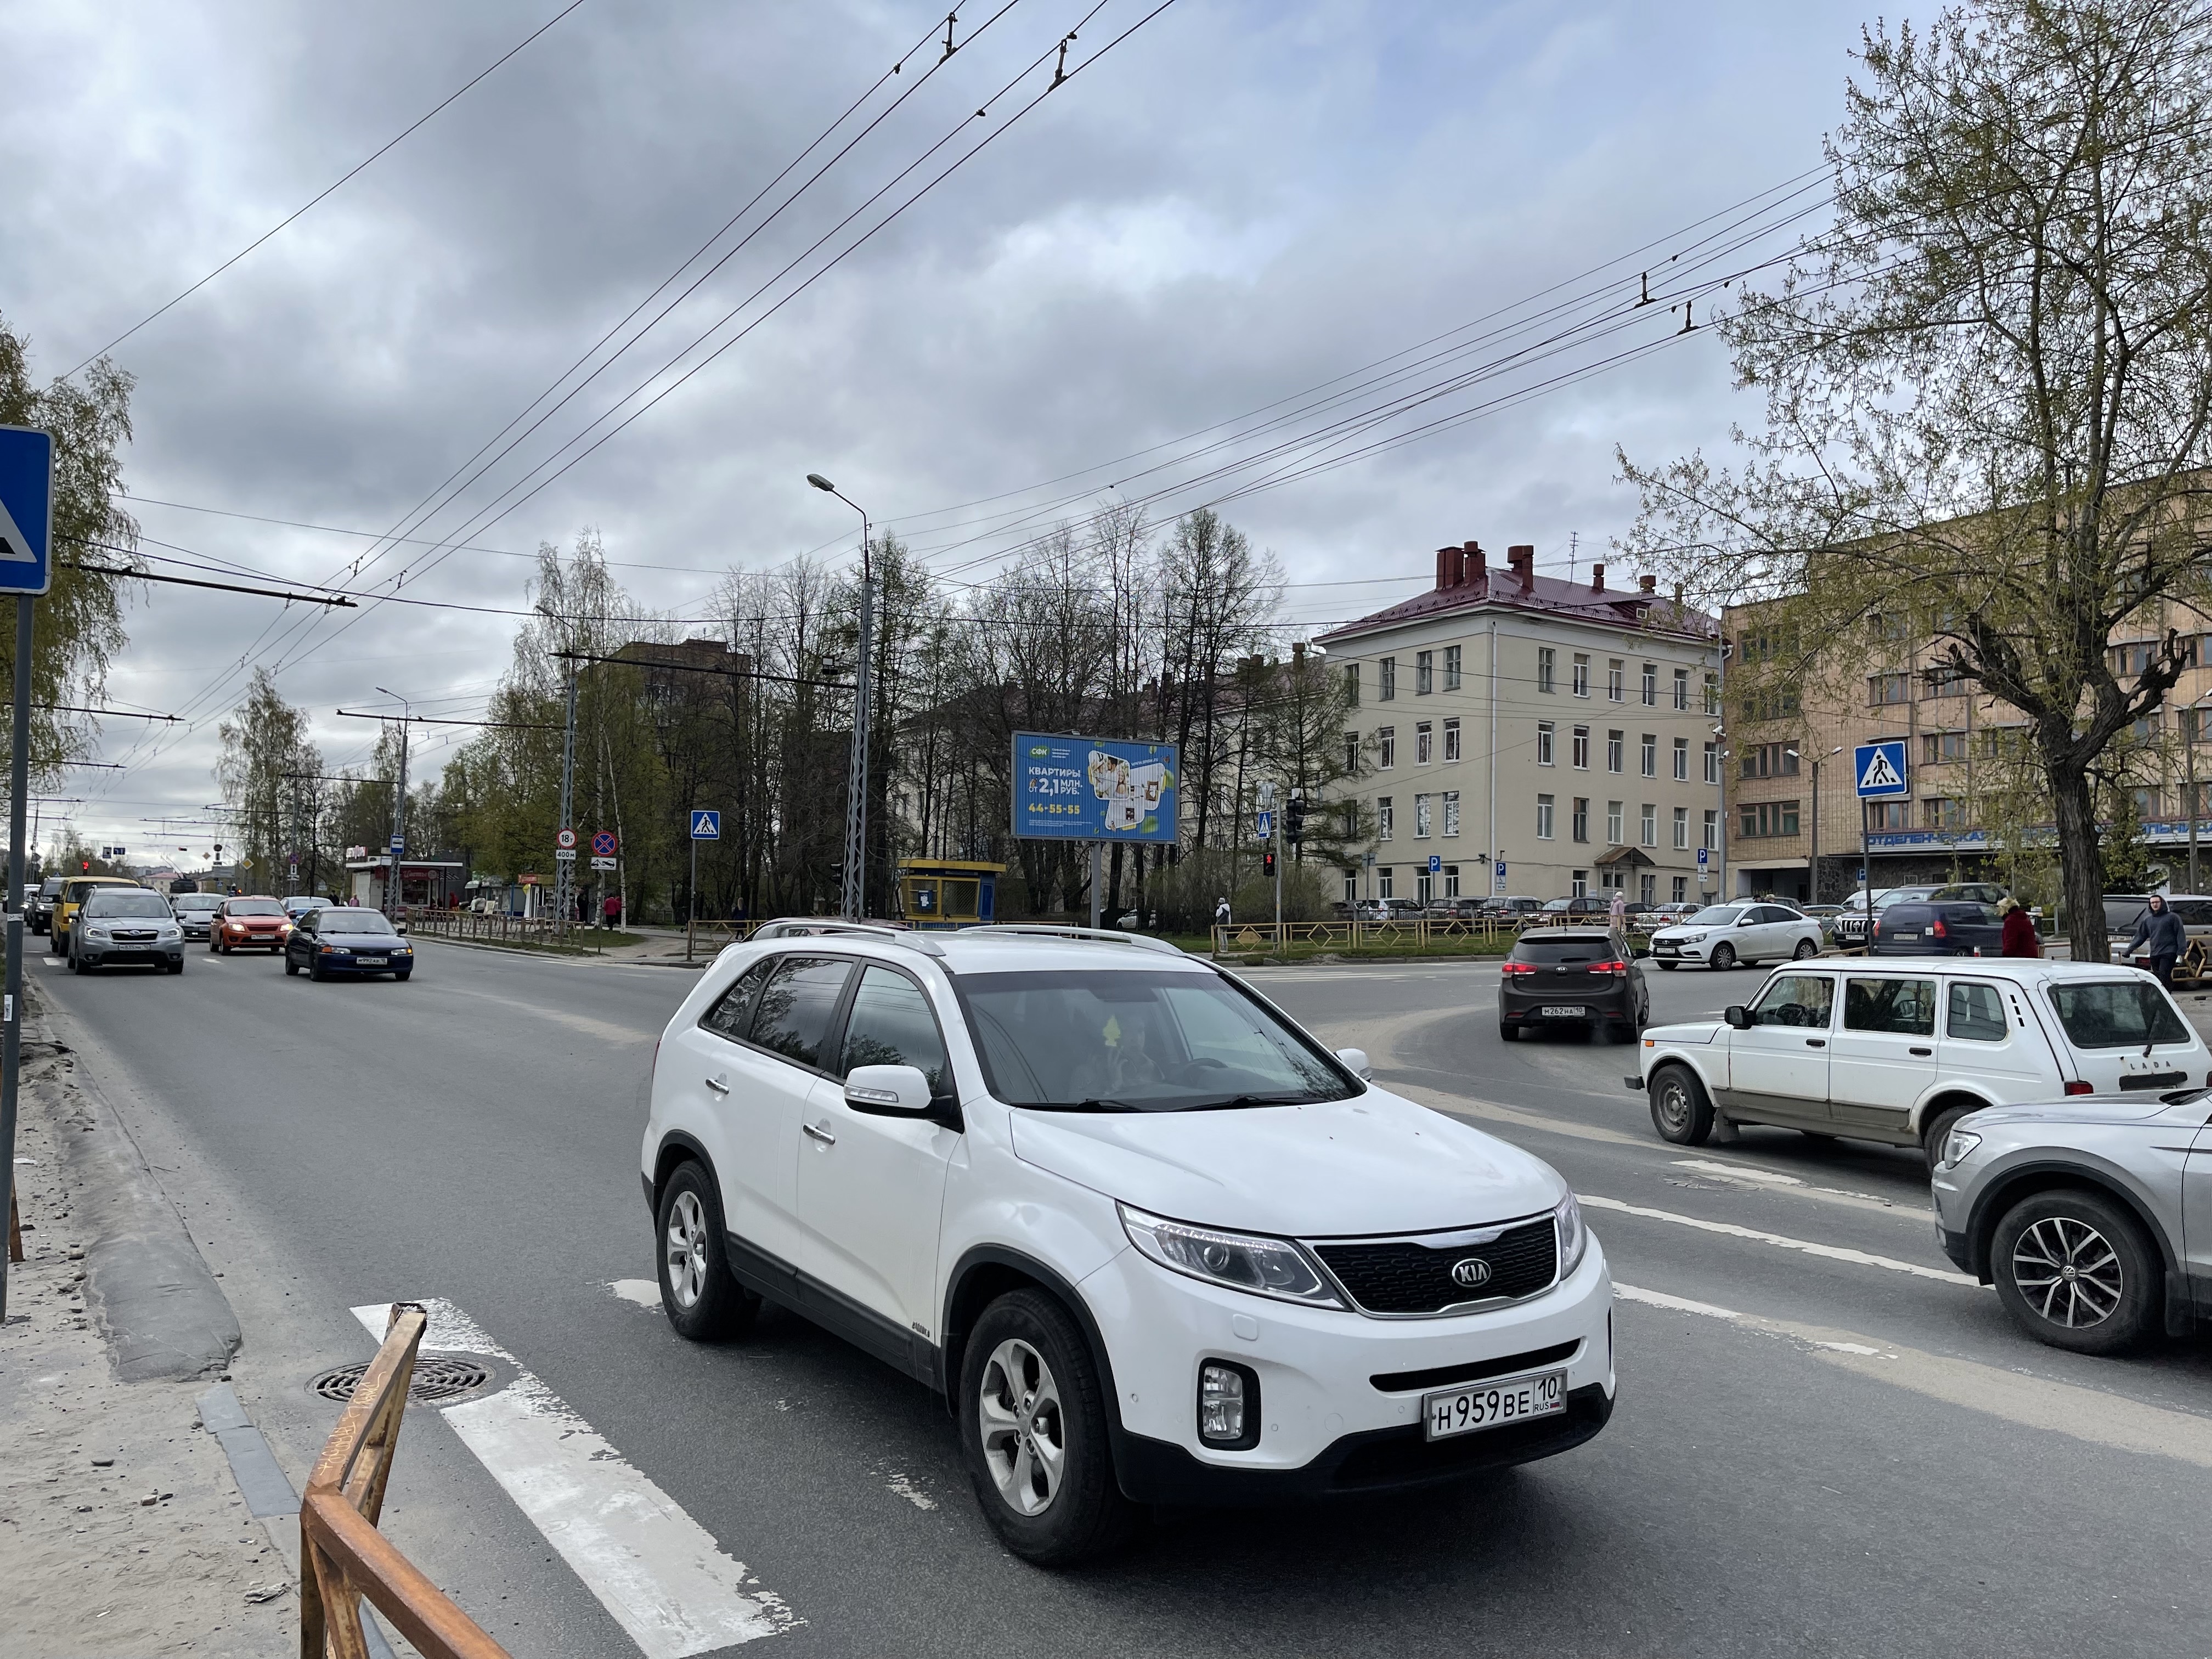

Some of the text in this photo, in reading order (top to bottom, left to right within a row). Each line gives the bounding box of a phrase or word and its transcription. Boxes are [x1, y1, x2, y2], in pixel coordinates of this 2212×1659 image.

[1029, 766, 1081, 777] КВАРТИРЫ
[1039, 778, 1059, 797] 2,1
[1060, 779, 1083, 788] МЛН.
[1060, 786, 1080, 795] РУБ.
[1029, 803, 1080, 814] 44-55-55
[1700, 850, 1706, 862] P
[1431, 857, 1438, 871] P
[1498, 864, 1504, 874] P
[1859, 868, 1866, 879] P
[2130, 1061, 2171, 1070] LADA
[1459, 1263, 1487, 1282] KIA
[1438, 1377, 1557, 1431] Н959ВЕ 10
[1534, 1401, 1549, 1412] RUS
